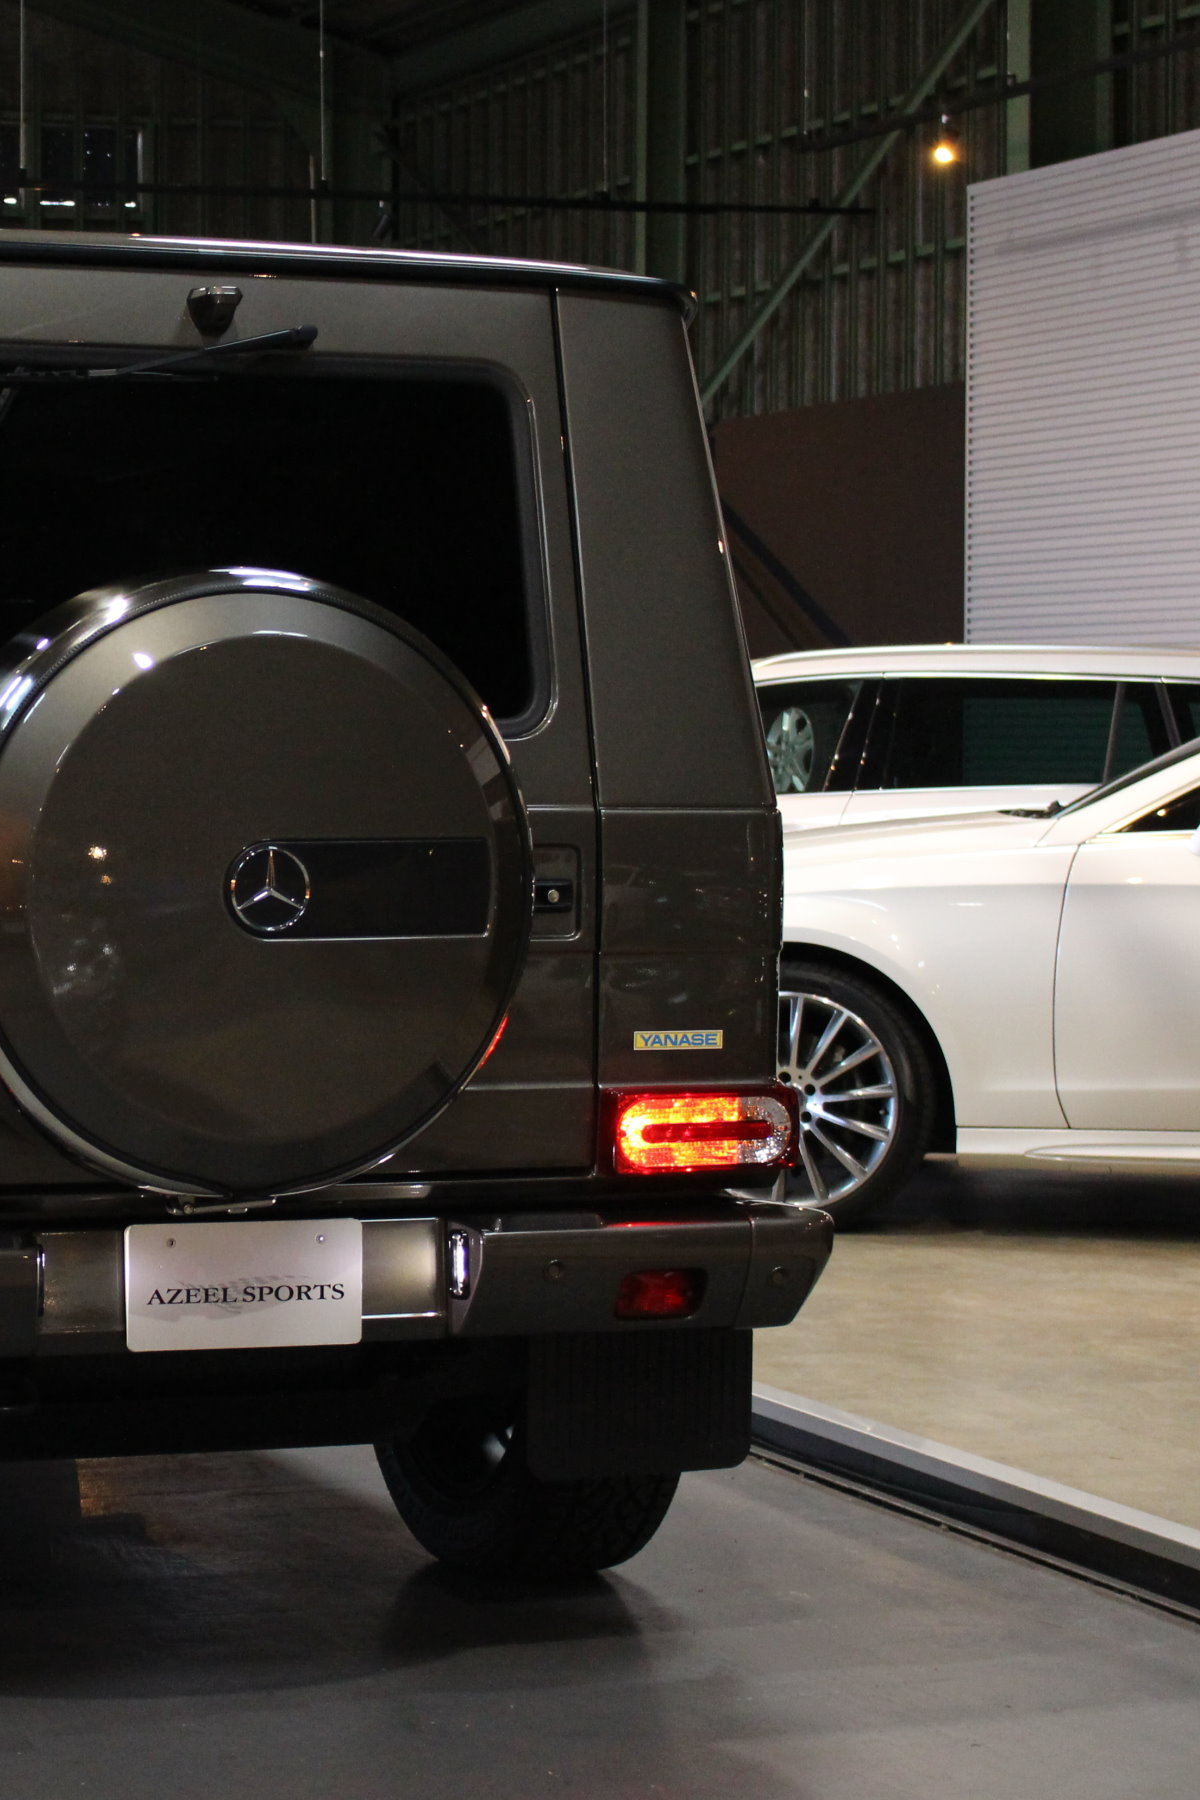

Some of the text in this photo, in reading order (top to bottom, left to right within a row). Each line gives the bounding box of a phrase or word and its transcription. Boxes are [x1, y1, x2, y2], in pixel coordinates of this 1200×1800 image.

[640, 1033, 718, 1047] YANASE
[147, 1283, 345, 1305] AZEEL SPORTS
